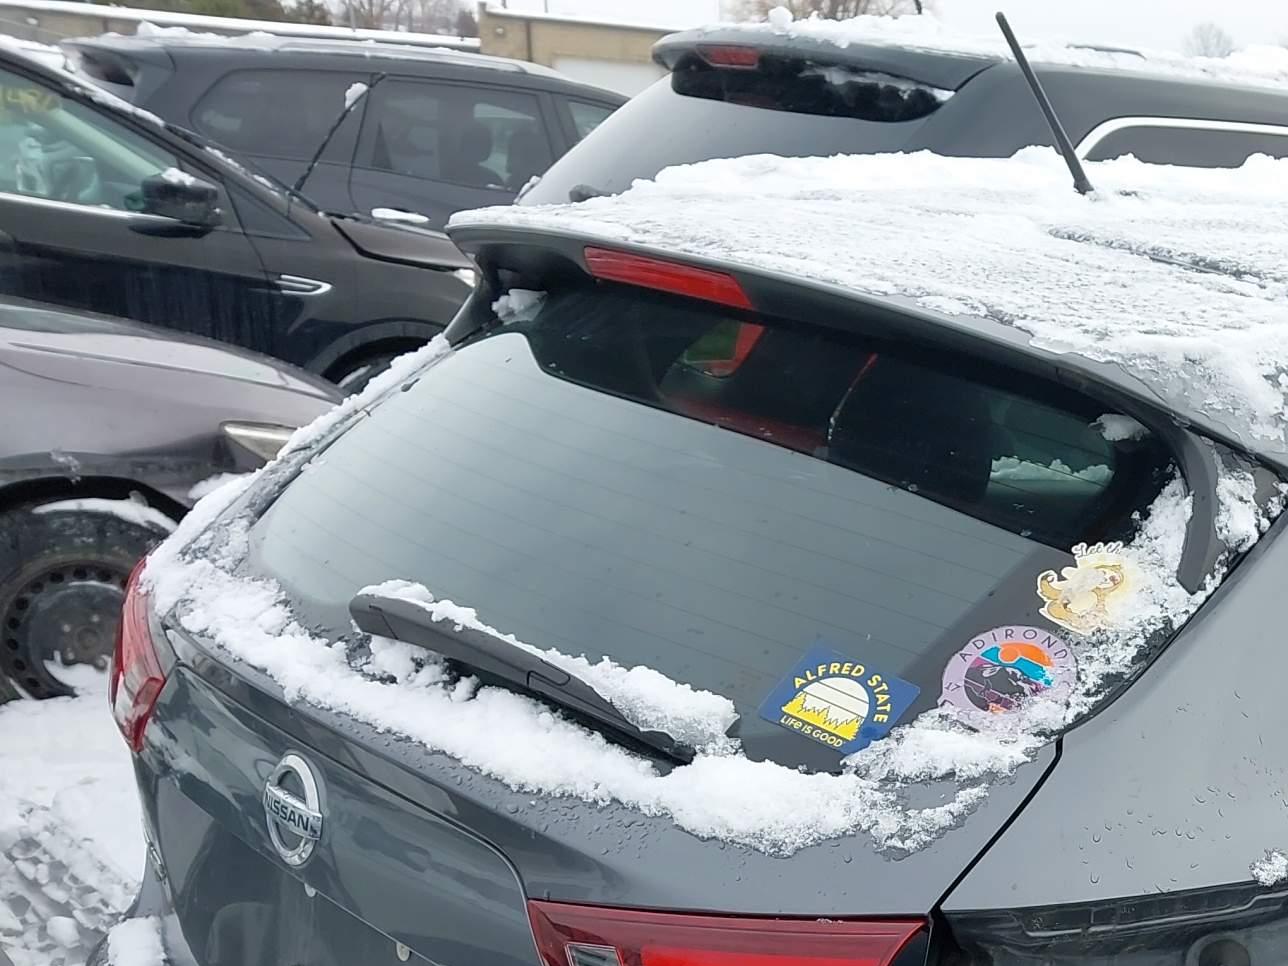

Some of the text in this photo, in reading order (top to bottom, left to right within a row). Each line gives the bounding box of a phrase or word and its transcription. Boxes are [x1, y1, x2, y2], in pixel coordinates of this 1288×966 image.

[792, 662, 865, 689] ALFRED
[866, 674, 892, 724] STATE
[812, 729, 845, 748] GOOD
[263, 790, 310, 833] NISSAN
